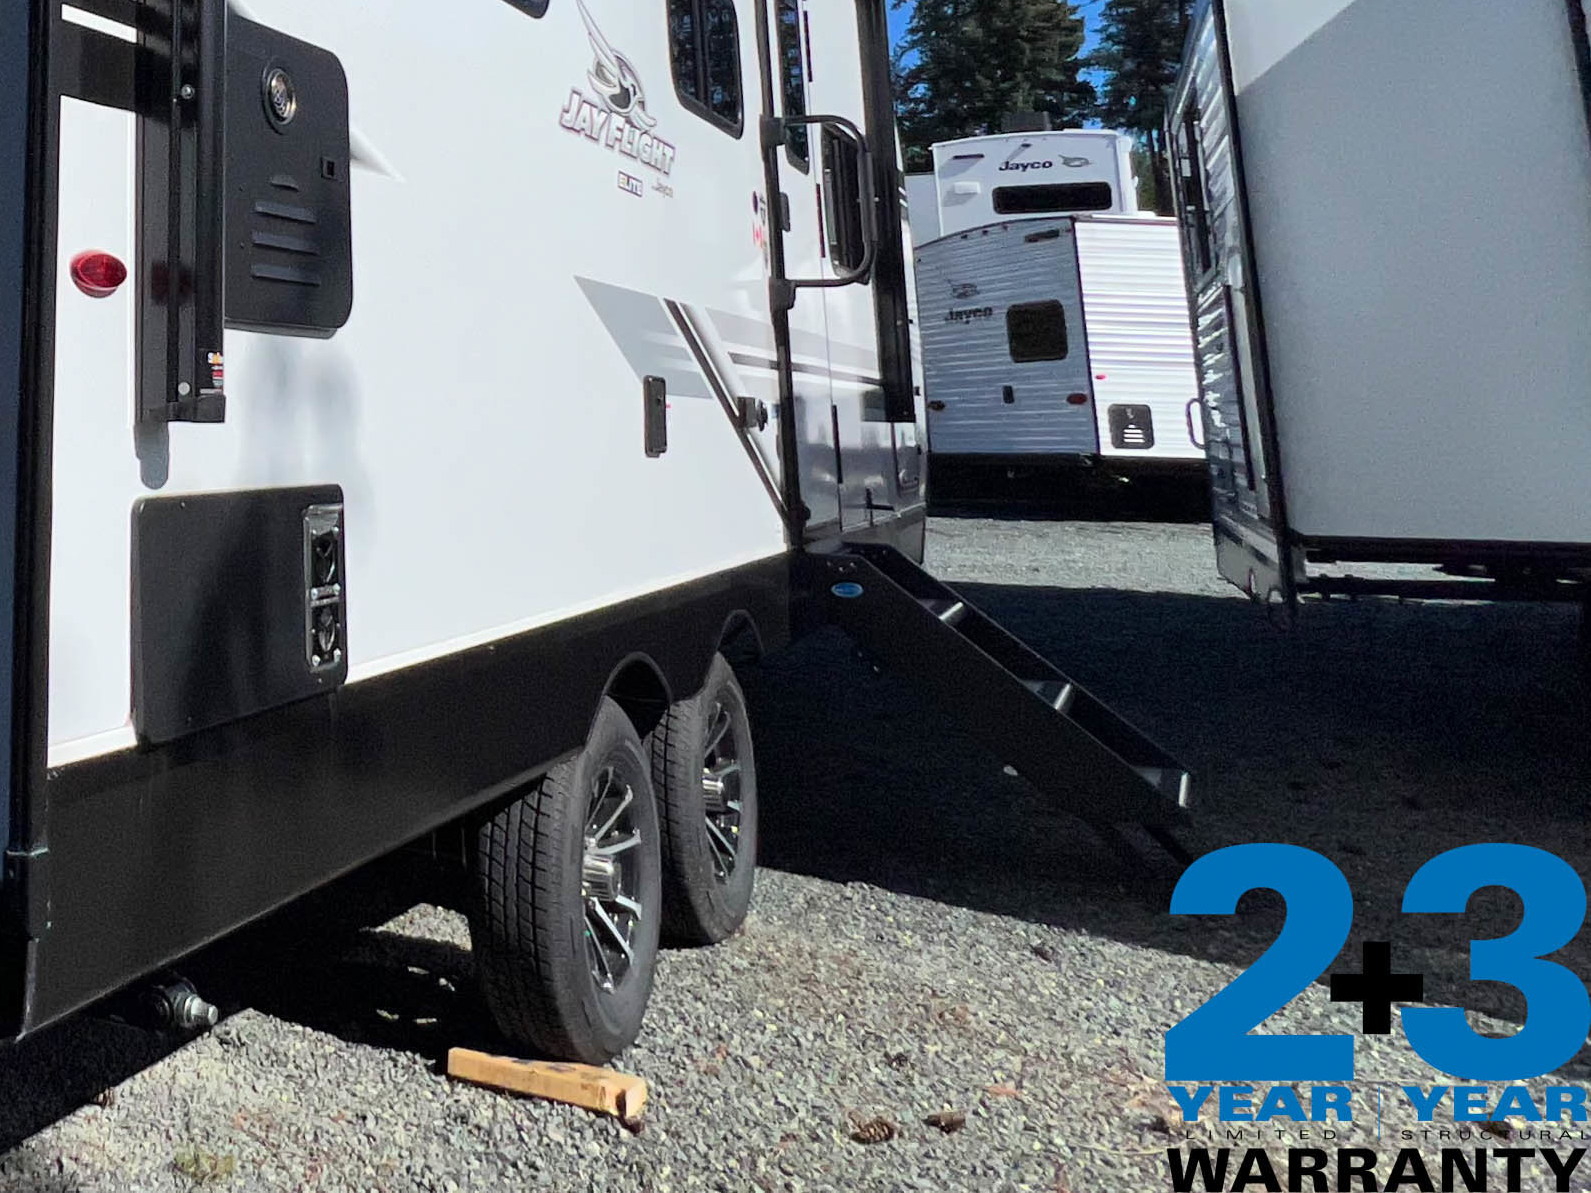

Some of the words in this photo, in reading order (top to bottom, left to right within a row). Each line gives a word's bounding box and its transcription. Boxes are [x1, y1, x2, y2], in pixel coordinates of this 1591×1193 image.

[559, 89, 610, 142] JAY
[605, 110, 676, 175] FLIGHT
[998, 160, 1053, 172] Jayco
